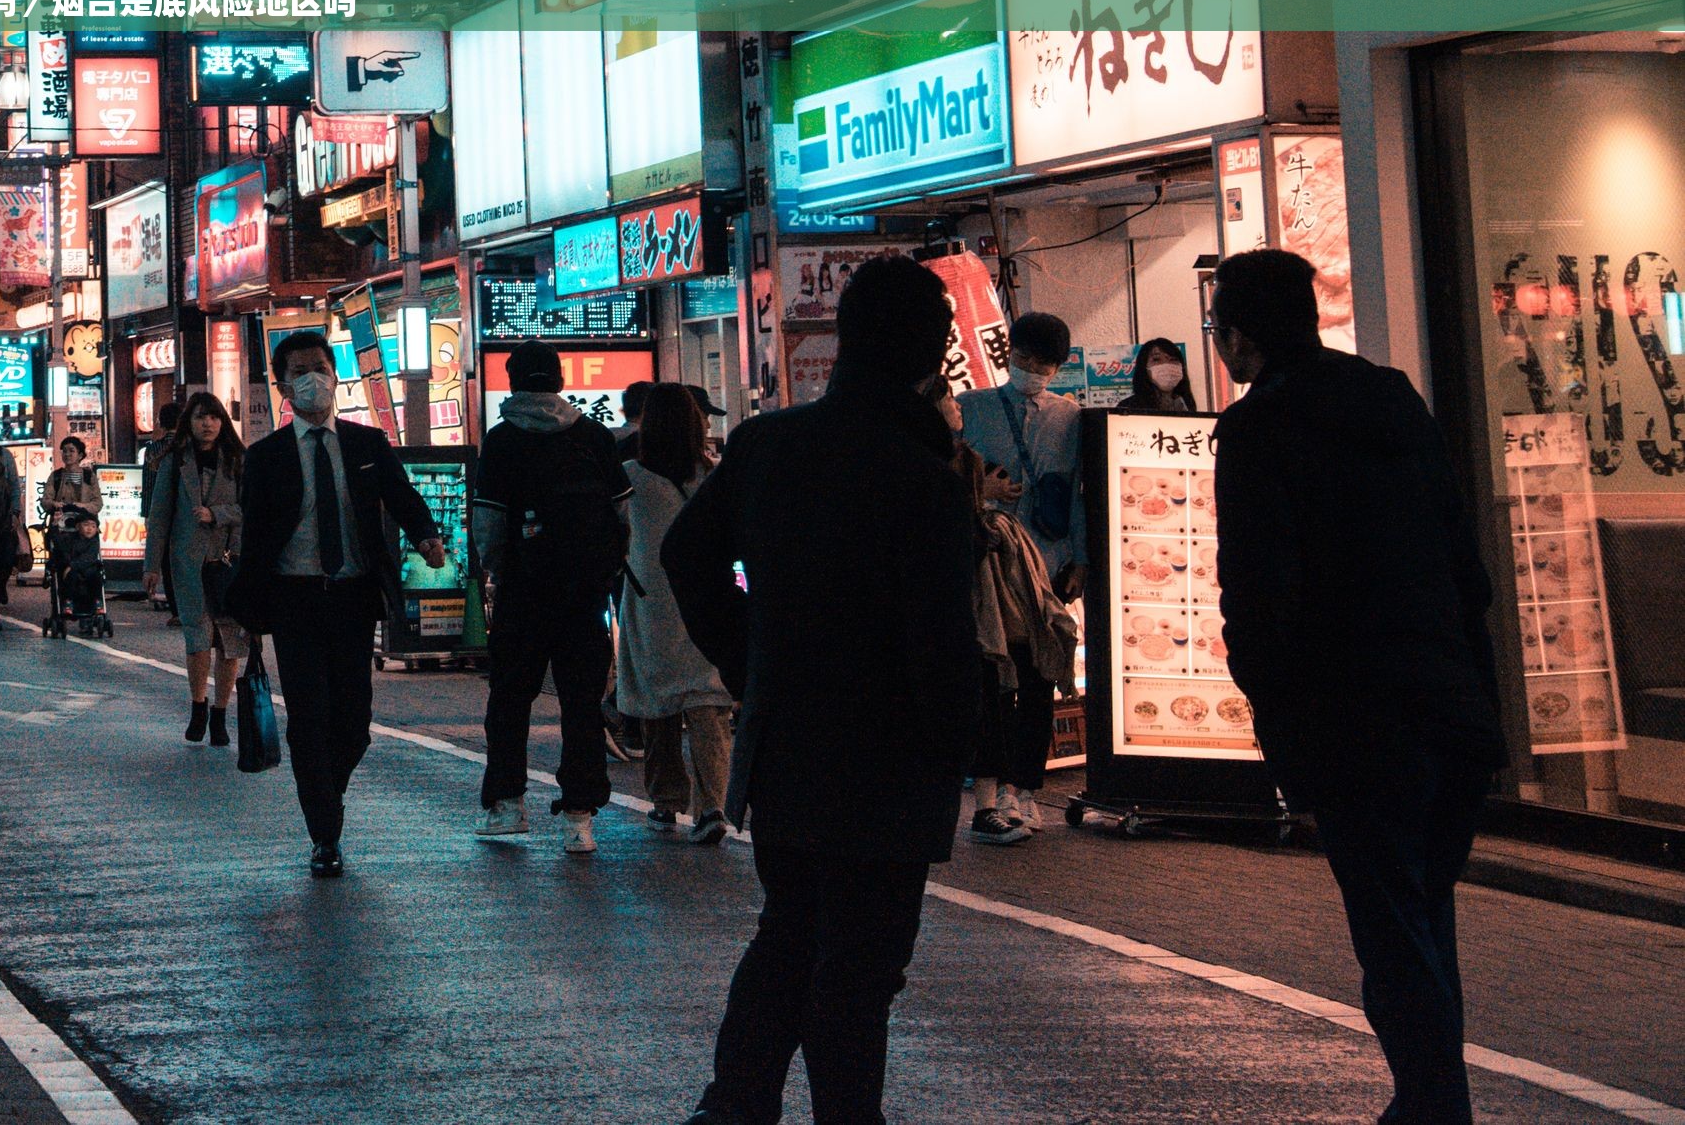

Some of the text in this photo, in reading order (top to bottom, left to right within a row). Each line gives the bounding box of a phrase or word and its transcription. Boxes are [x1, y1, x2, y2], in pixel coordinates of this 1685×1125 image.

[82, 70, 151, 85] 電子タバコ
[835, 69, 992, 165] FamilyMart
[1285, 153, 1316, 231] 牛たん
[641, 208, 702, 278] ラーメン
